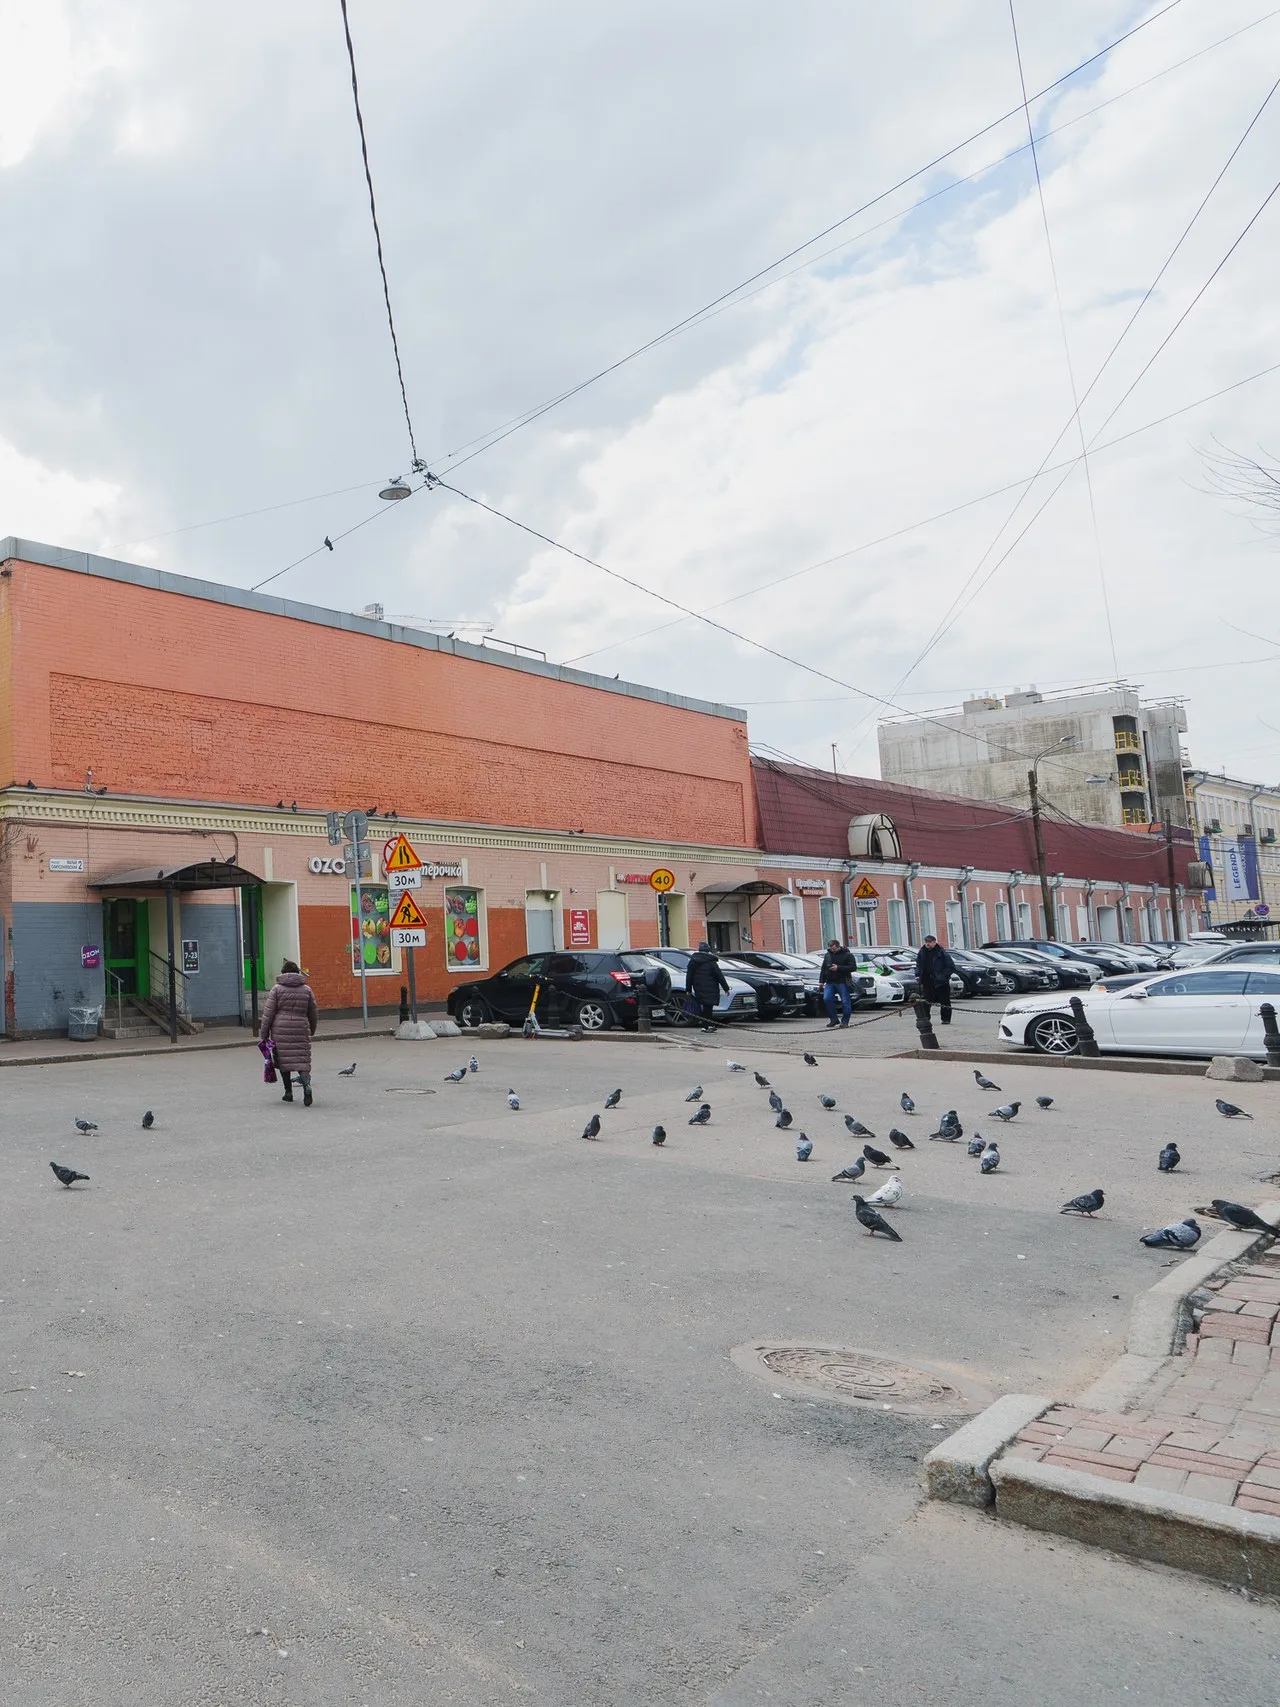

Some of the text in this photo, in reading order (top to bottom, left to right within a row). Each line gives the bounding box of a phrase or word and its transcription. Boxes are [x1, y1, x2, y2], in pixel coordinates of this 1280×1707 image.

[78, 860, 83, 870] 2
[309, 856, 353, 873] OZO
[1229, 847, 1241, 889] LEGENDA
[394, 875, 416, 887] 30м
[654, 875, 670, 885] 40
[398, 933, 420, 944] 30м
[184, 951, 198, 959] 7-23
